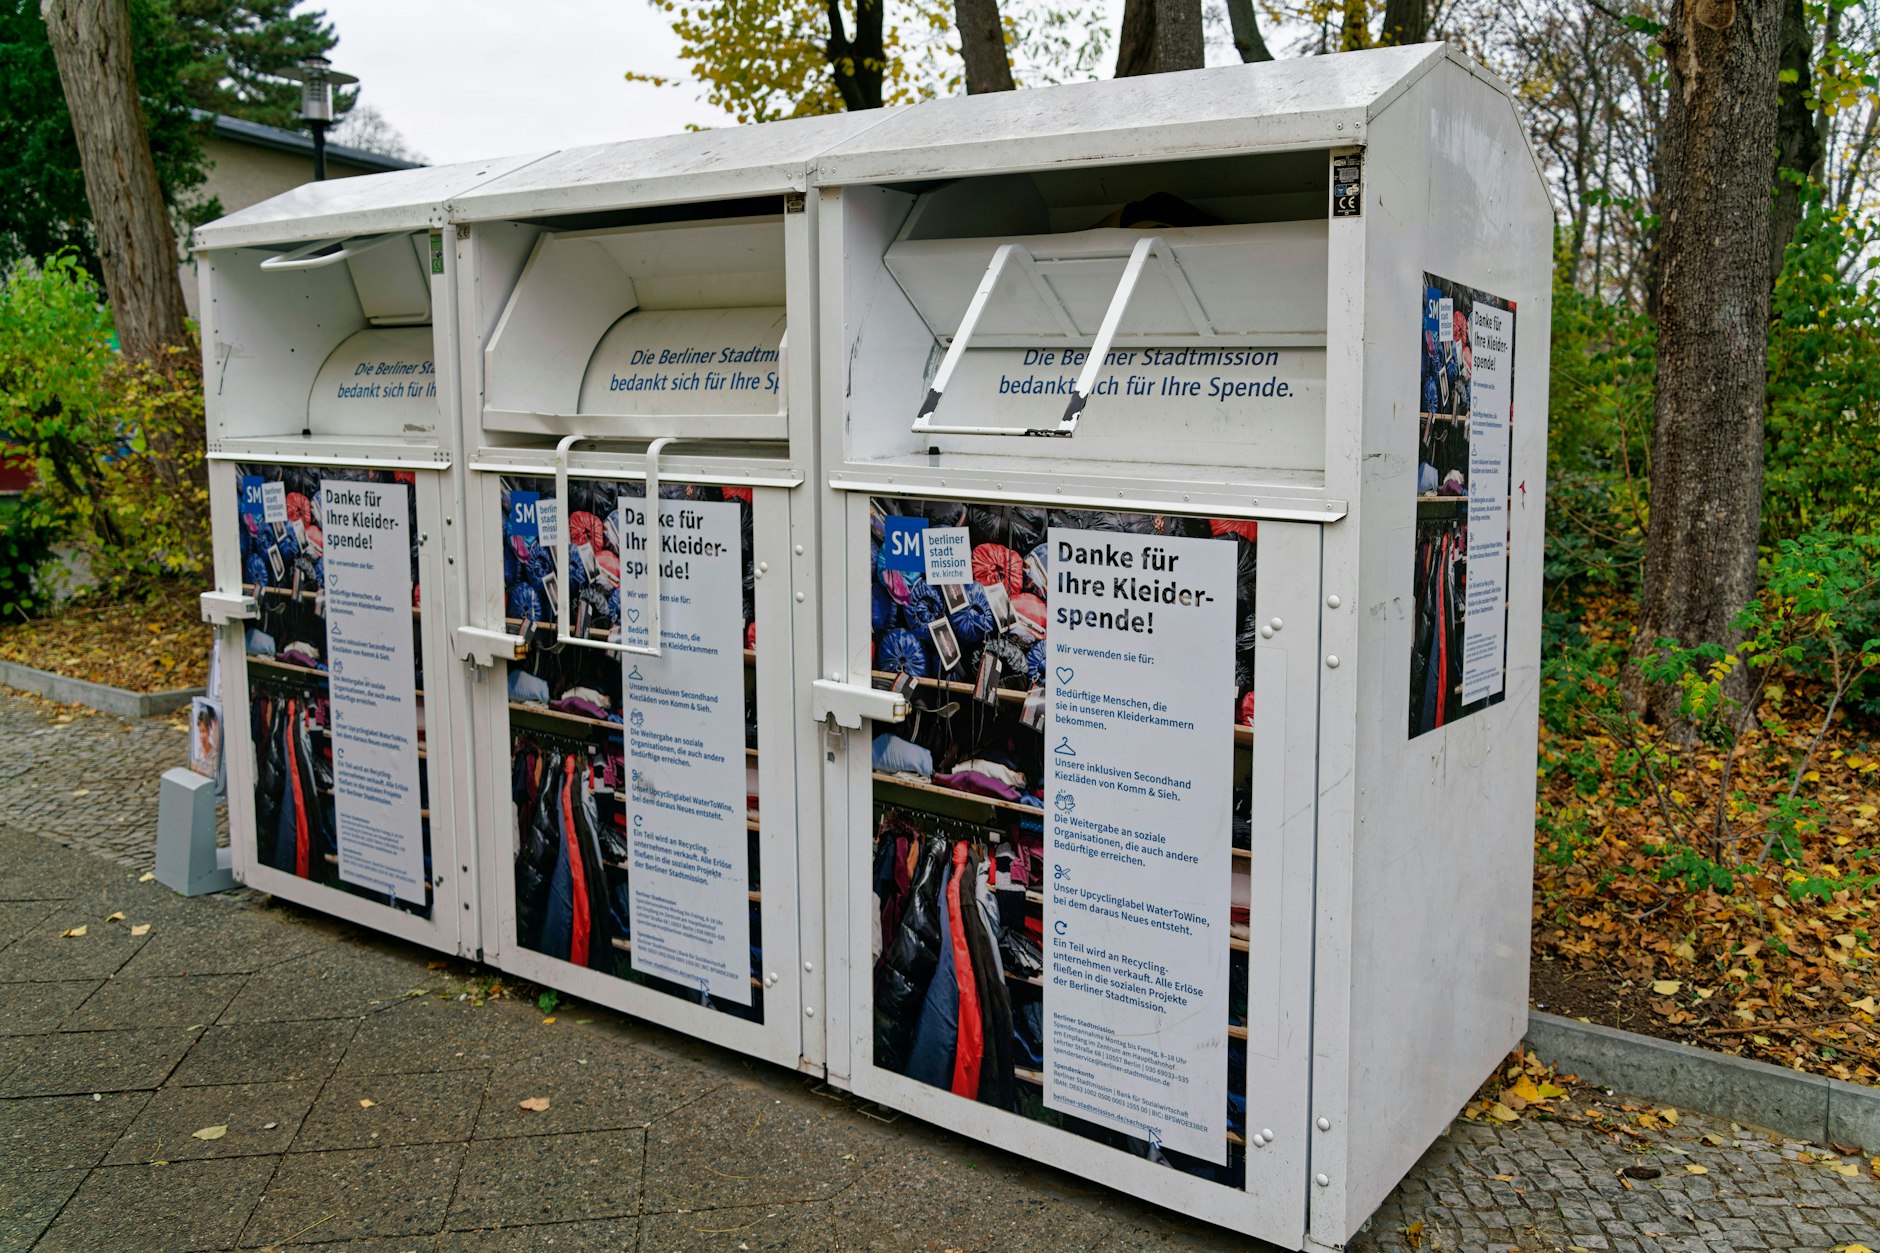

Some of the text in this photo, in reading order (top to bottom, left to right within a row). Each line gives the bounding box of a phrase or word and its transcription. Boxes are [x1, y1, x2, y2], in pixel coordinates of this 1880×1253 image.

[1339, 196, 1355, 209] CE
[1429, 299, 1438, 320] SM
[1475, 311, 1502, 331] Danke für
[1474, 331, 1508, 353] Ihre Kleider-
[630, 346, 779, 365] Die Berliner Stadtmi
[1024, 347, 1278, 366] Die Bener Stadtmission
[1474, 355, 1496, 372] spende!
[354, 362, 374, 376] Die
[375, 361, 418, 374] Berliner
[338, 382, 380, 398] bedankt
[382, 382, 404, 398] sich
[407, 381, 423, 398] für
[610, 374, 668, 391] bedankt
[671, 372, 700, 390] sich
[704, 372, 726, 390] für
[730, 372, 760, 390] Ihre
[1000, 376, 1076, 395] bedankt
[1126, 376, 1155, 396] für
[1161, 376, 1200, 396] Ihre
[1208, 376, 1294, 402] Spende.
[246, 486, 262, 503] SM
[327, 490, 381, 507] Danke für
[327, 510, 399, 529] Ihre Kleider-
[515, 503, 535, 524] SM
[679, 510, 703, 530] für
[328, 534, 372, 549] spende!
[662, 535, 727, 556] Kleider-
[892, 530, 920, 556] SM
[929, 534, 964, 545] berliner
[930, 546, 954, 557] stadt
[1058, 541, 1178, 571] Danke für
[932, 558, 966, 568] mission
[942, 570, 963, 578] kirche
[1058, 571, 1214, 606] Ihre Kleider-
[1057, 607, 1154, 634] spende!
[1056, 643, 1154, 664] Wir verwenden sie für:
[629, 682, 718, 702] Unsere inklusiven Secondhand
[1056, 687, 1167, 712] Bedürftige Menschen, die
[1055, 700, 1194, 729] sie in unseren Kleiderkammern
[1055, 713, 1107, 730] bekommen.
[631, 728, 639, 736] Die
[640, 730, 673, 742] Weitergabe
[682, 739, 703, 748] soziale
[1055, 757, 1191, 789] Unsere inklusiven Secondhand
[1054, 770, 1180, 801] Kiezläden von Komm & Sieh.
[1054, 813, 1166, 843] Die Weitergabe an soziale
[1054, 826, 1199, 864] Organisationen, die auch andere
[1054, 839, 1146, 866] Bedürftige erreichen.
[635, 860, 709, 885] der Berliner Stadtmission.
[1053, 882, 1210, 927] Unser Upcyclinglabel WaterToWine,
[1053, 894, 1192, 935] bei dem daraus Neues entsteht.
[1053, 937, 1169, 975] Ein Teil wird an Recycling-
[1053, 951, 1203, 996] unternehmen verkauft. Alle Erlöse
[1053, 962, 1187, 1006] fließen in die sozialen Projekte
[1053, 975, 1167, 1013] der Berliner Stadtmission.
[1053, 1012, 1115, 1035] Berliner Stadtmission
[1053, 1061, 1094, 1079] Spendenkonto
